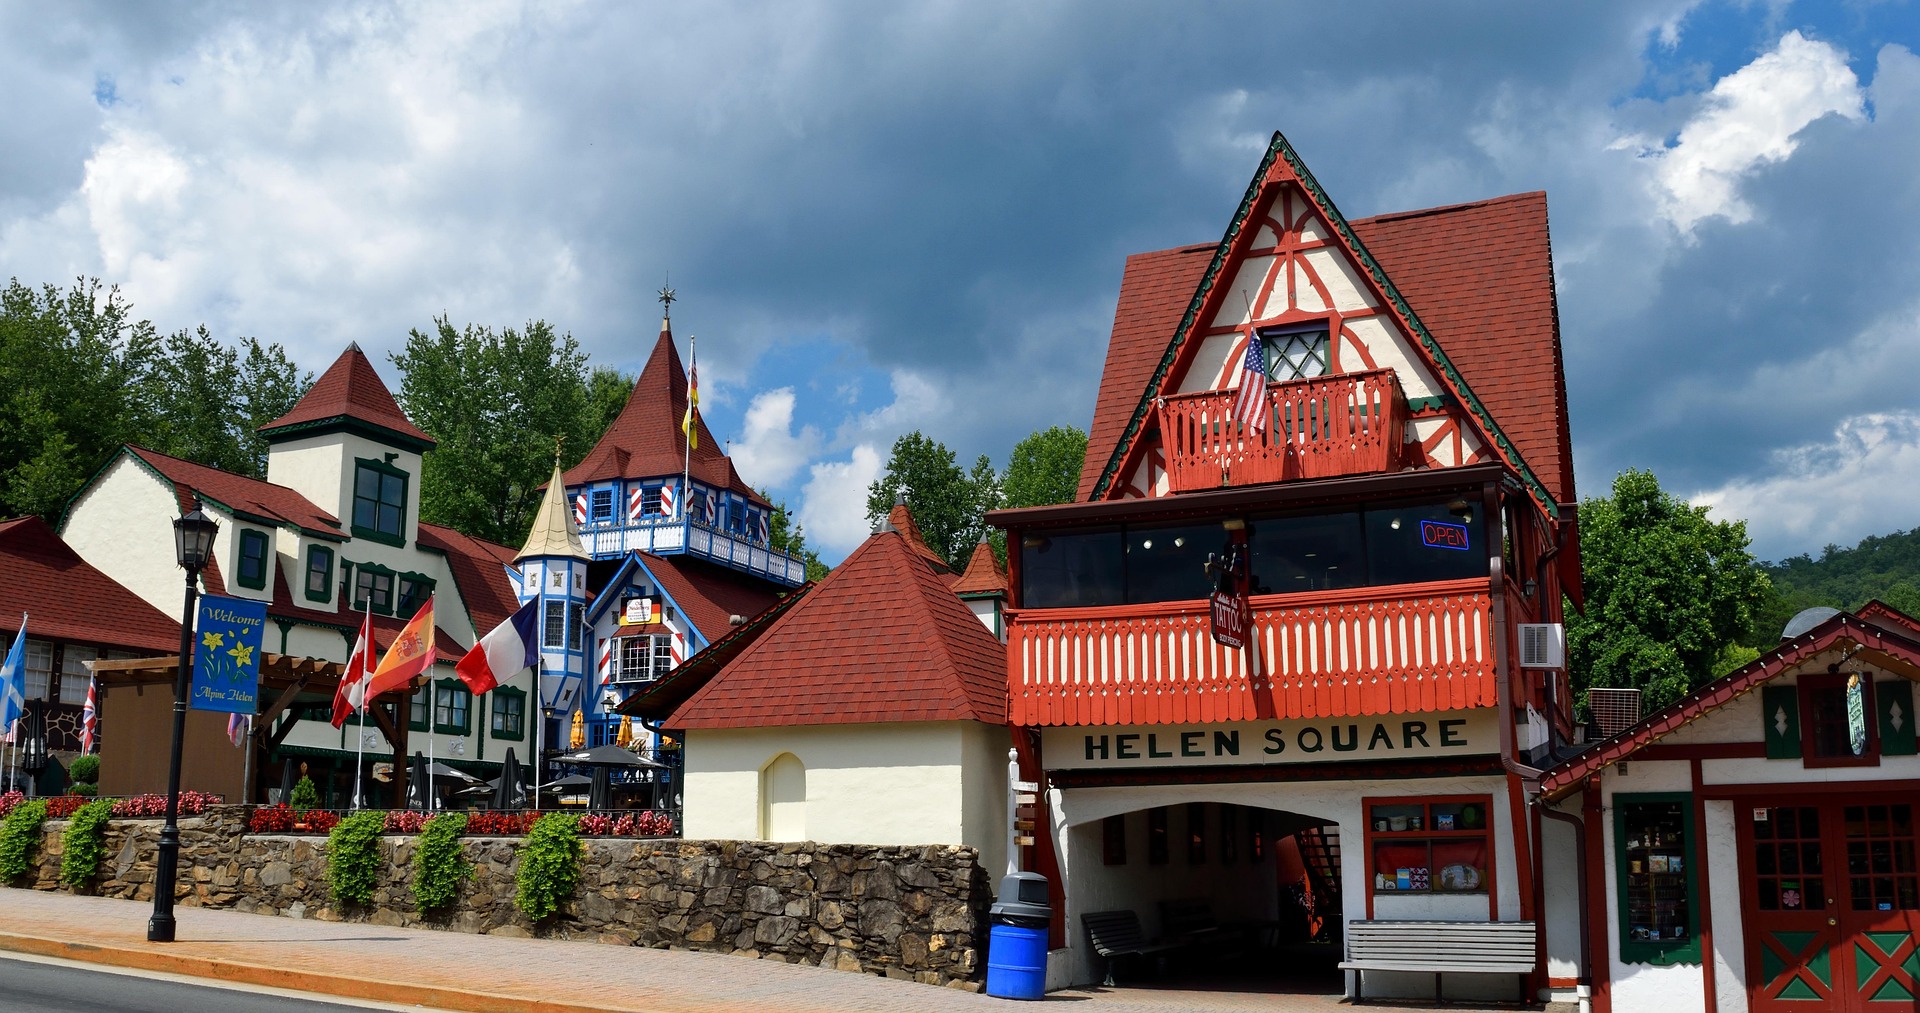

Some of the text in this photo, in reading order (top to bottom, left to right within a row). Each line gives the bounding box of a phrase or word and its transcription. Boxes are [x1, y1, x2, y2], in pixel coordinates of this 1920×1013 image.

[1424, 524, 1467, 547] OPEN
[201, 606, 261, 626] Welcome
[195, 686, 253, 702] Alpine Helen
[1085, 719, 1468, 760] HELEN SQUARE
